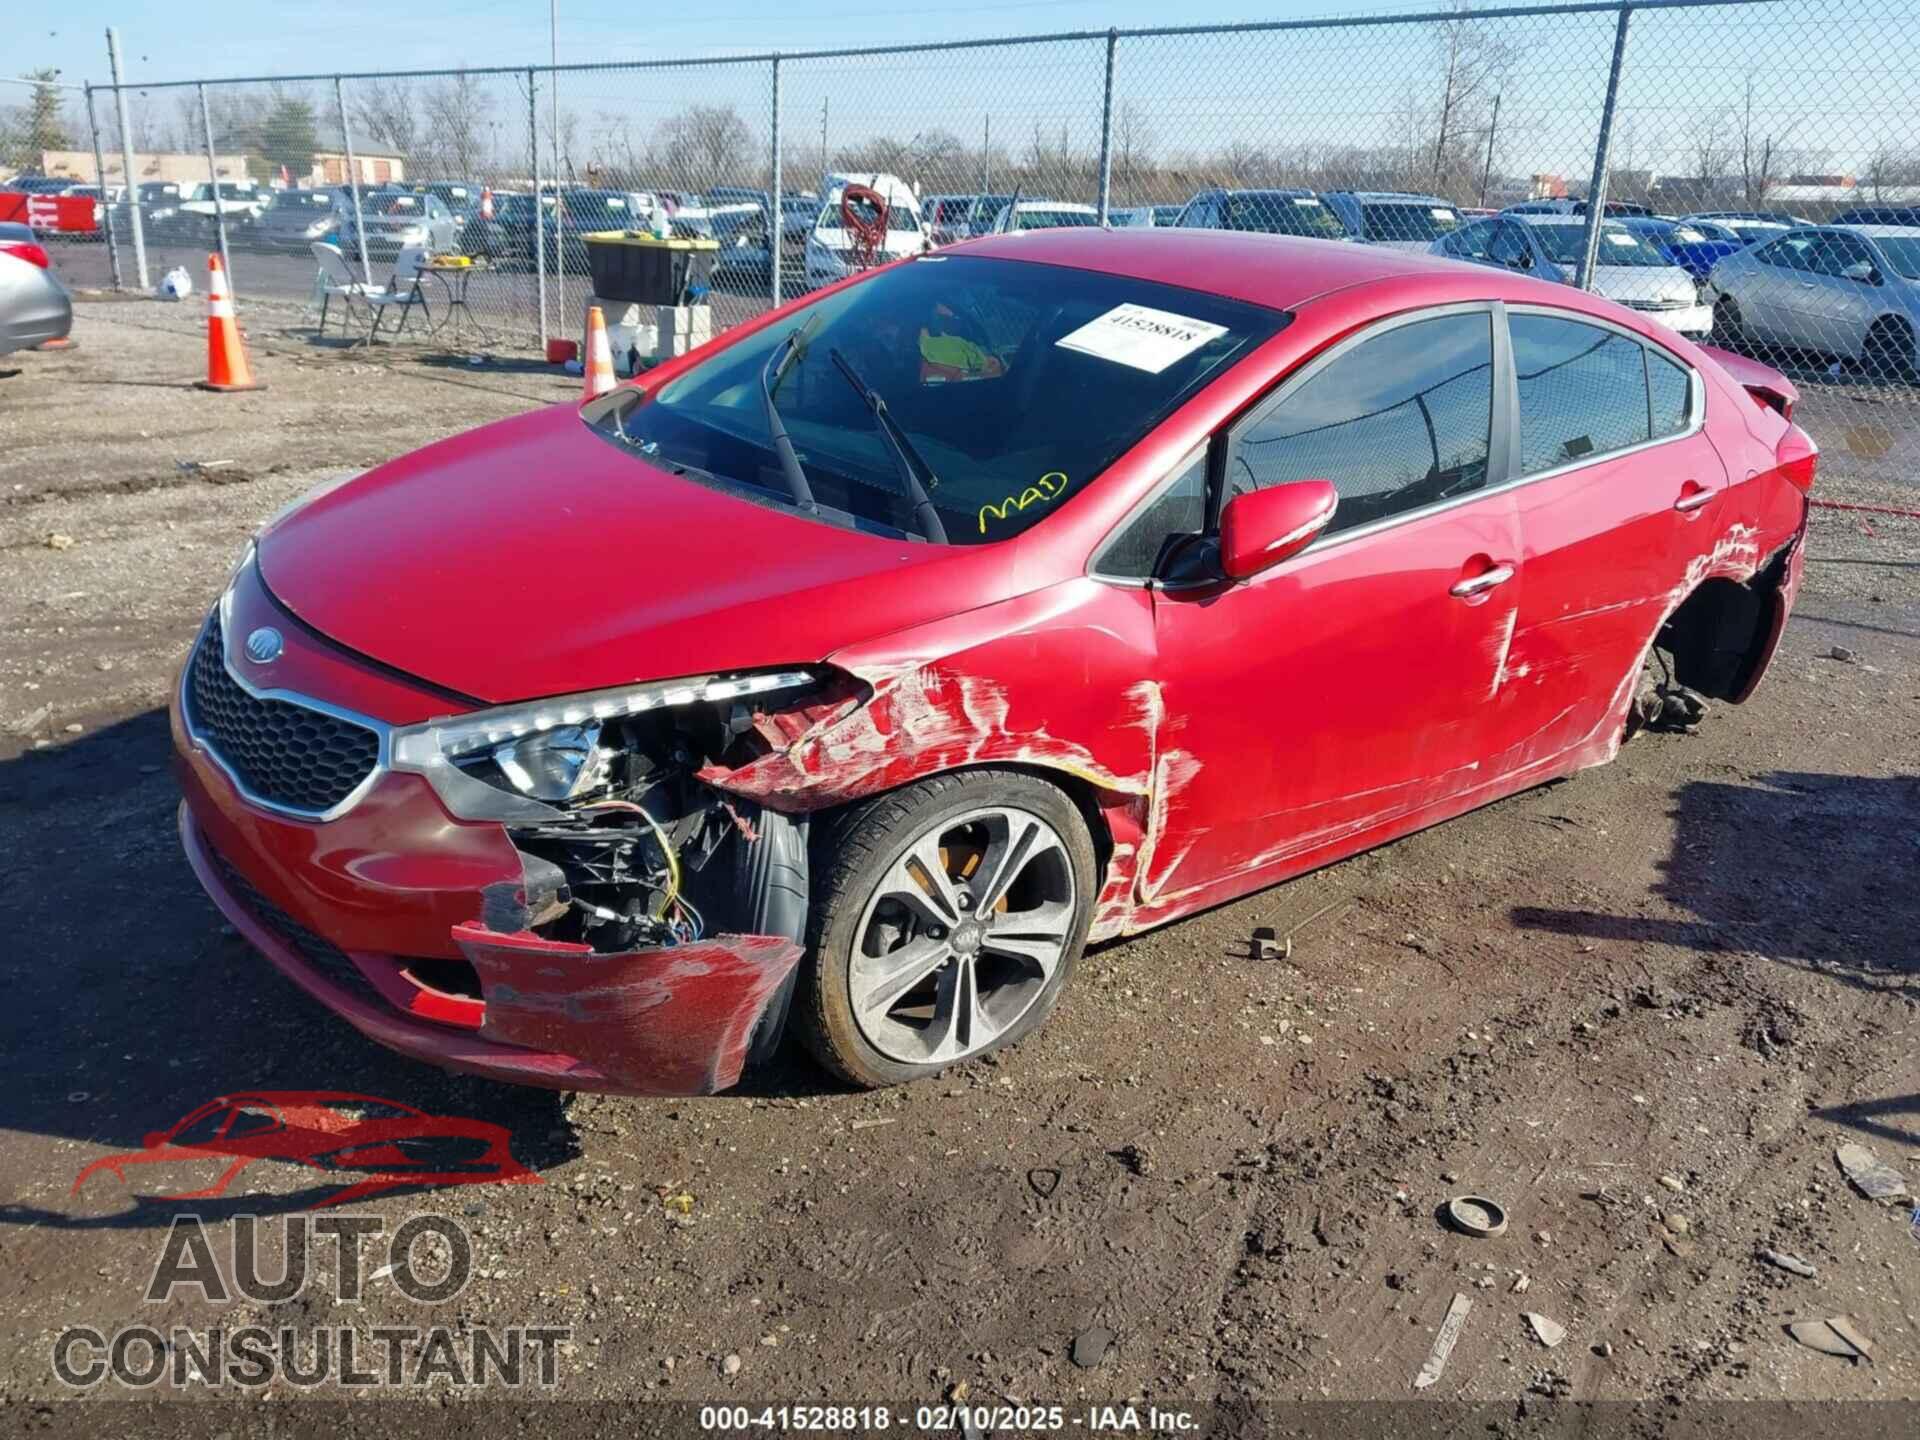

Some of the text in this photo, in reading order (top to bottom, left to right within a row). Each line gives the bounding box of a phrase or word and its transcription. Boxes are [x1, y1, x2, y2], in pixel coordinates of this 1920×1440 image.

[26, 193, 59, 228] RT
[1109, 314, 1198, 341] 41528818
[979, 471, 1068, 534] MAD
